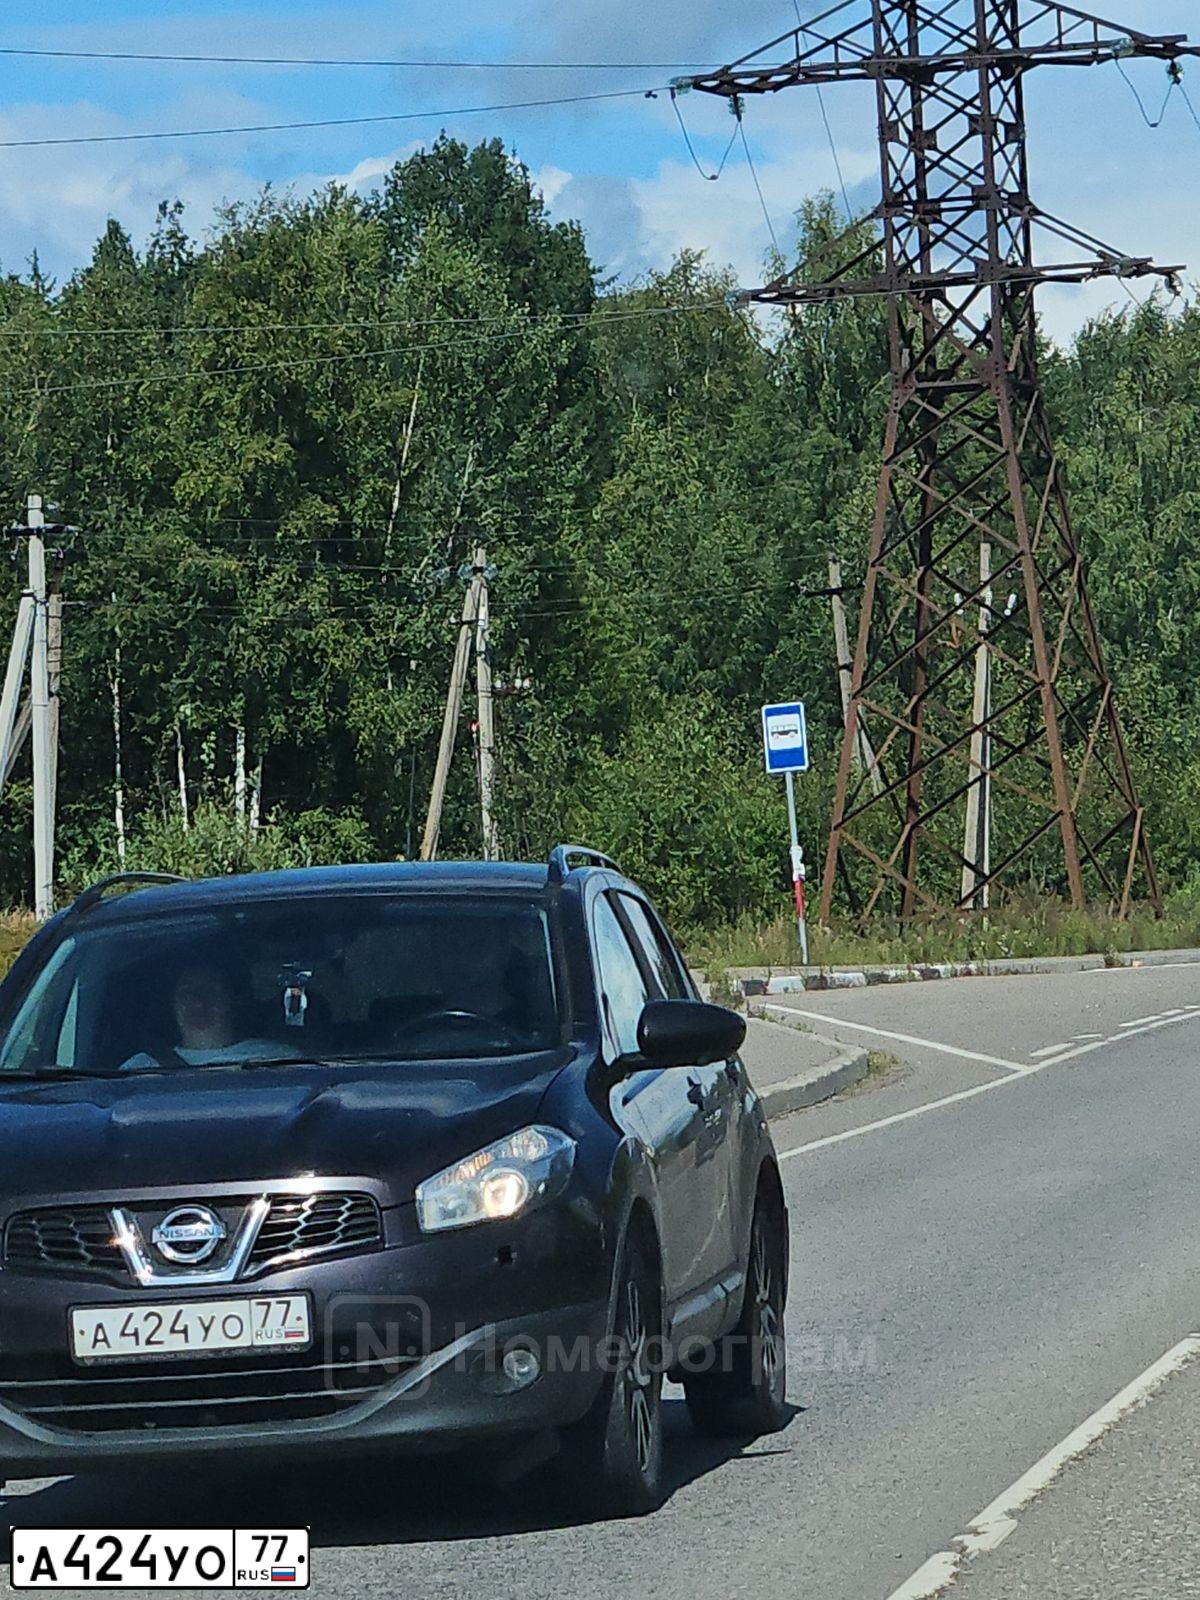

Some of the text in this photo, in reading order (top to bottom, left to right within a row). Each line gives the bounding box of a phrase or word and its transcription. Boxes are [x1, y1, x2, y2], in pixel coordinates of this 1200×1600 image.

[159, 1226, 215, 1239] NISSAN
[255, 1300, 292, 1328] 77
[255, 1330, 283, 1340] RUS
